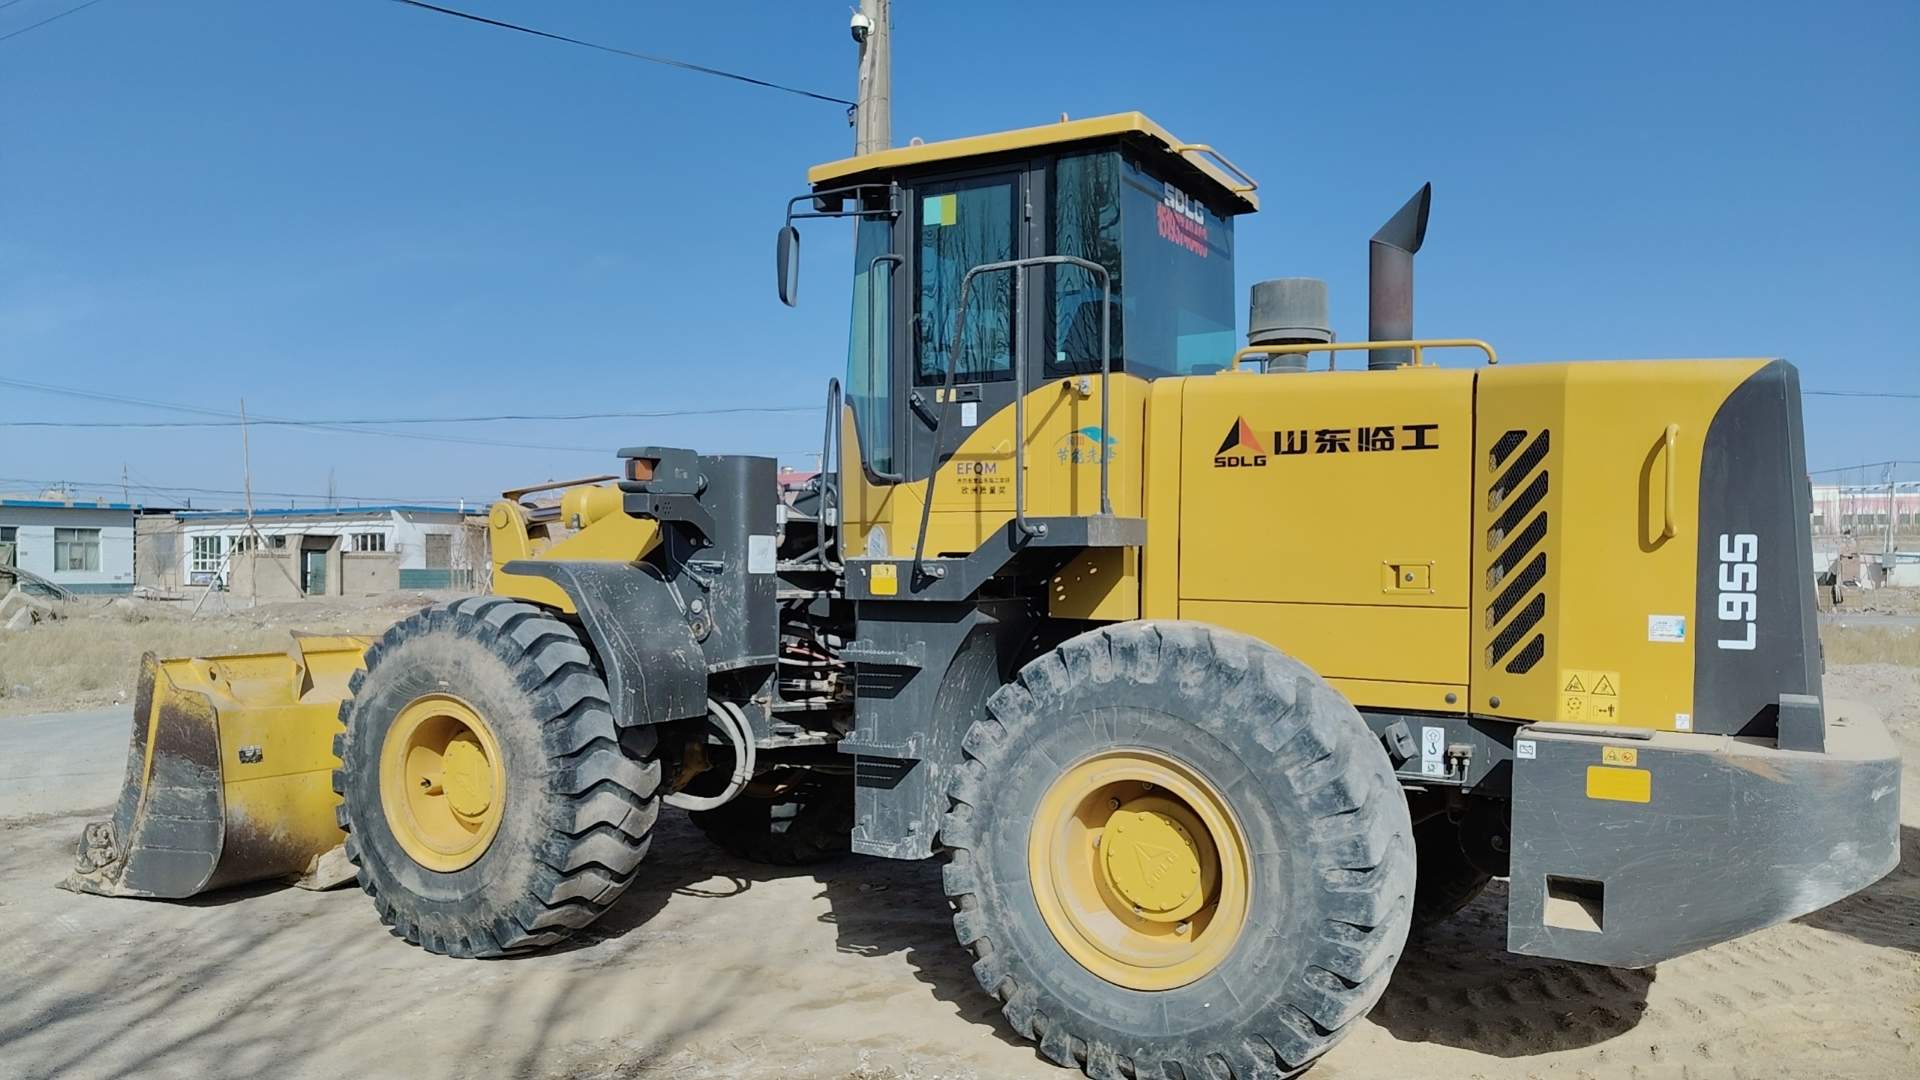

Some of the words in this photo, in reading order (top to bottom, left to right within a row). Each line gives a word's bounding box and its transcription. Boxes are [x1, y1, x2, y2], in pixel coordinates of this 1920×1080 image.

[1164, 181, 1204, 225] SDLG
[1274, 424, 1439, 455] 山东临工
[957, 462, 997, 475] EFQM
[1214, 455, 1267, 468] SDLG
[1717, 534, 1758, 651] L955
